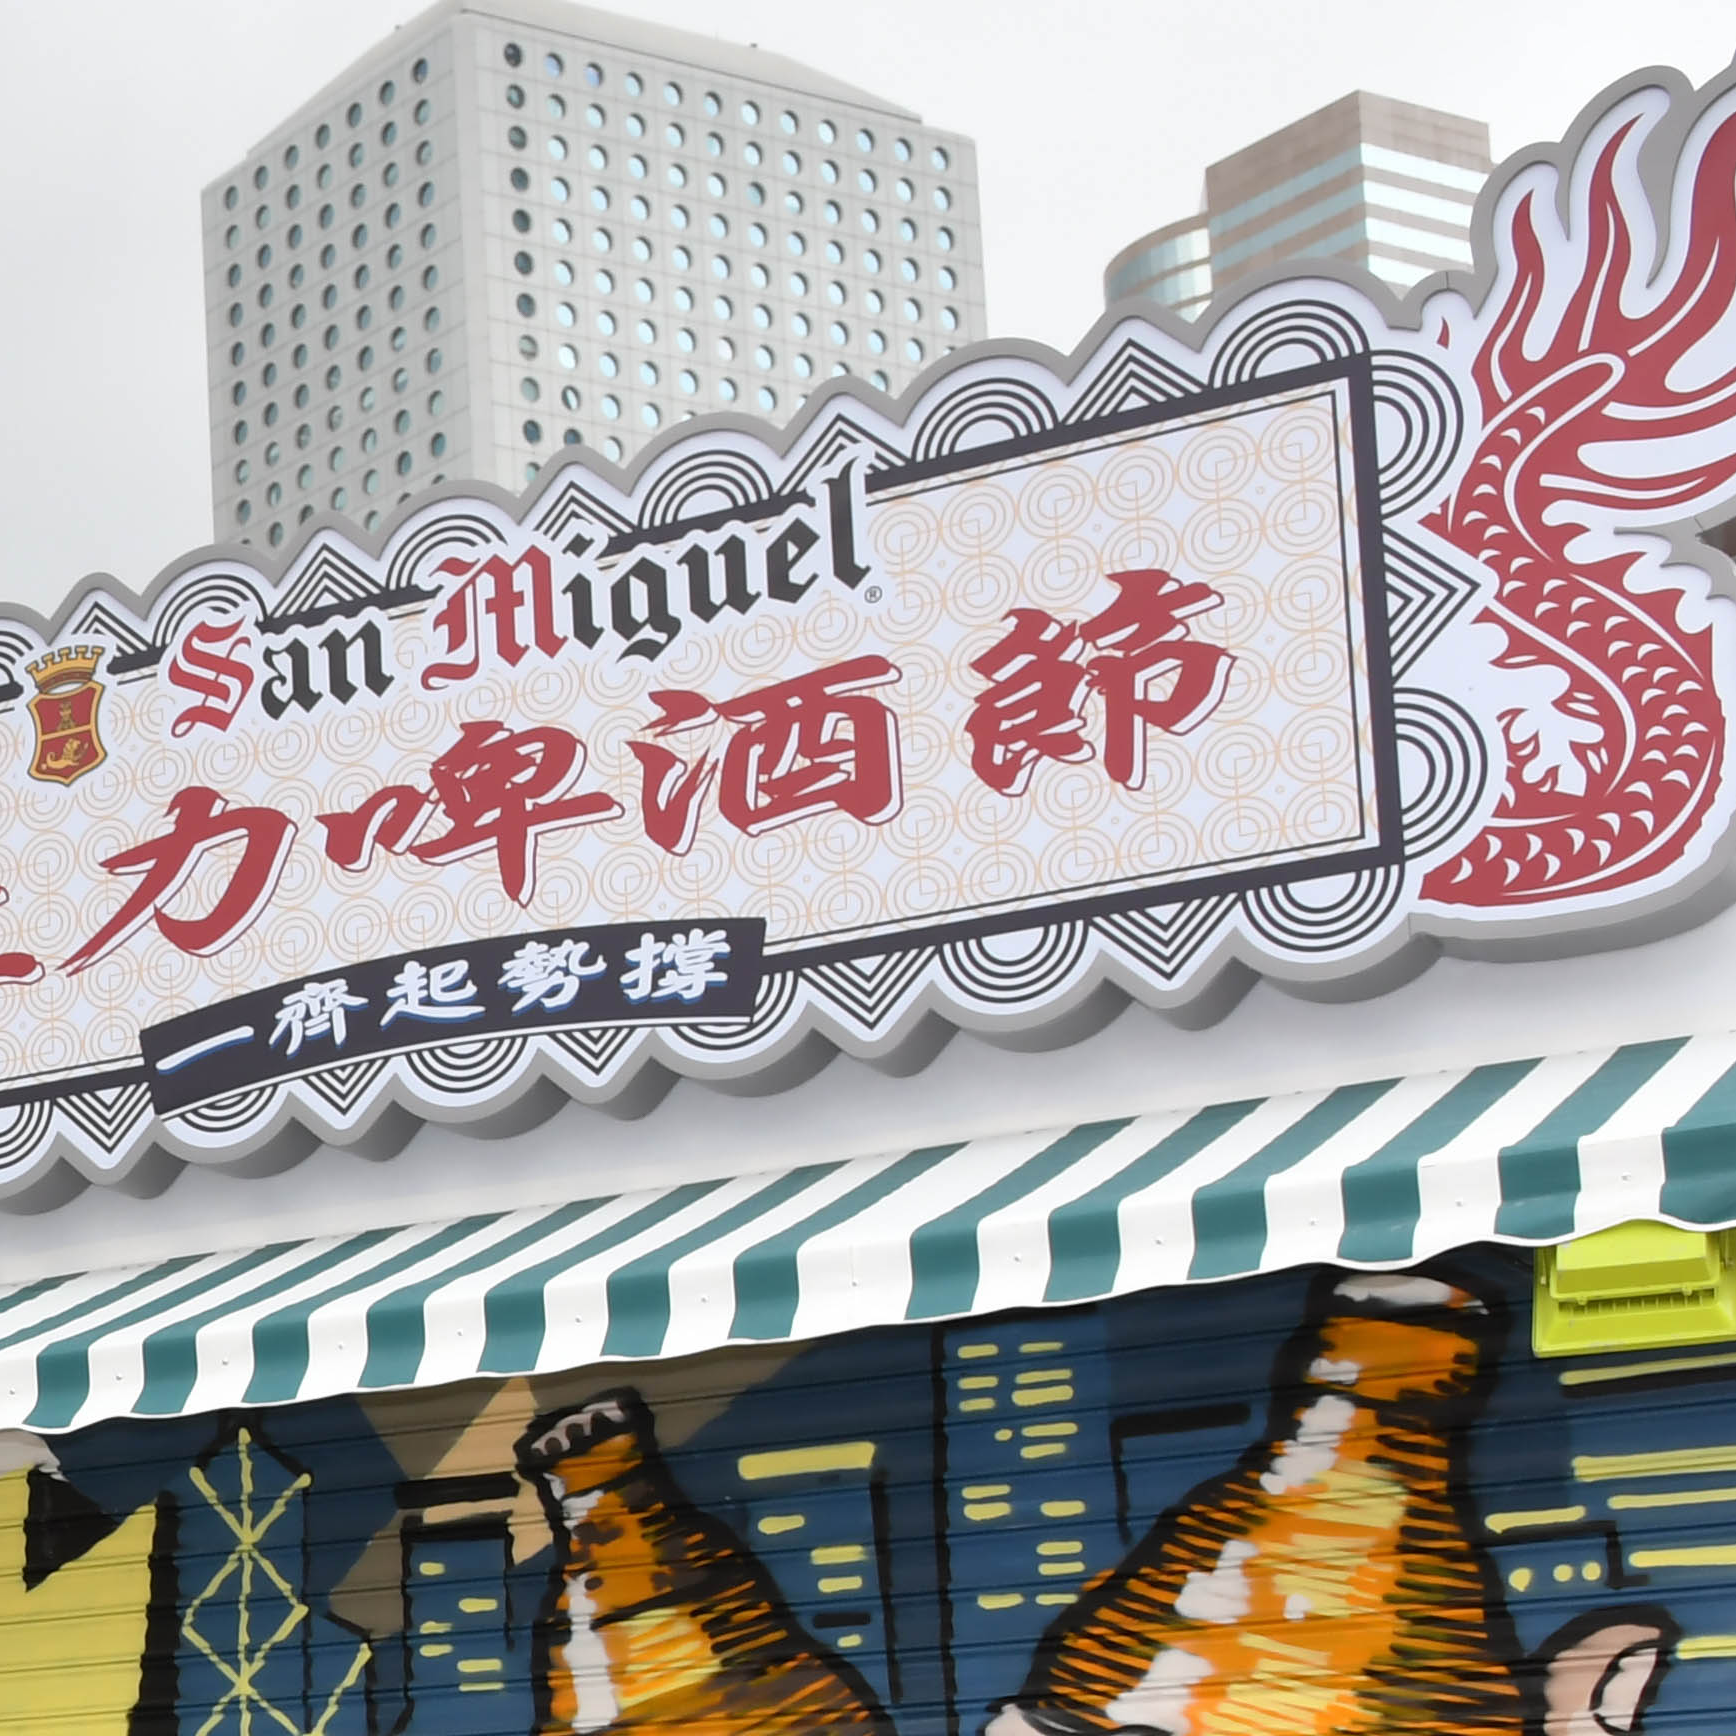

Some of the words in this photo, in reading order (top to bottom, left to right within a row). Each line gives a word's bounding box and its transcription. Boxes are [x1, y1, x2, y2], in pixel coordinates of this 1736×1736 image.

[168, 615, 395, 739] San
[420, 457, 873, 691] Miguel
[155, 927, 731, 1075] 一齊起勢撐
